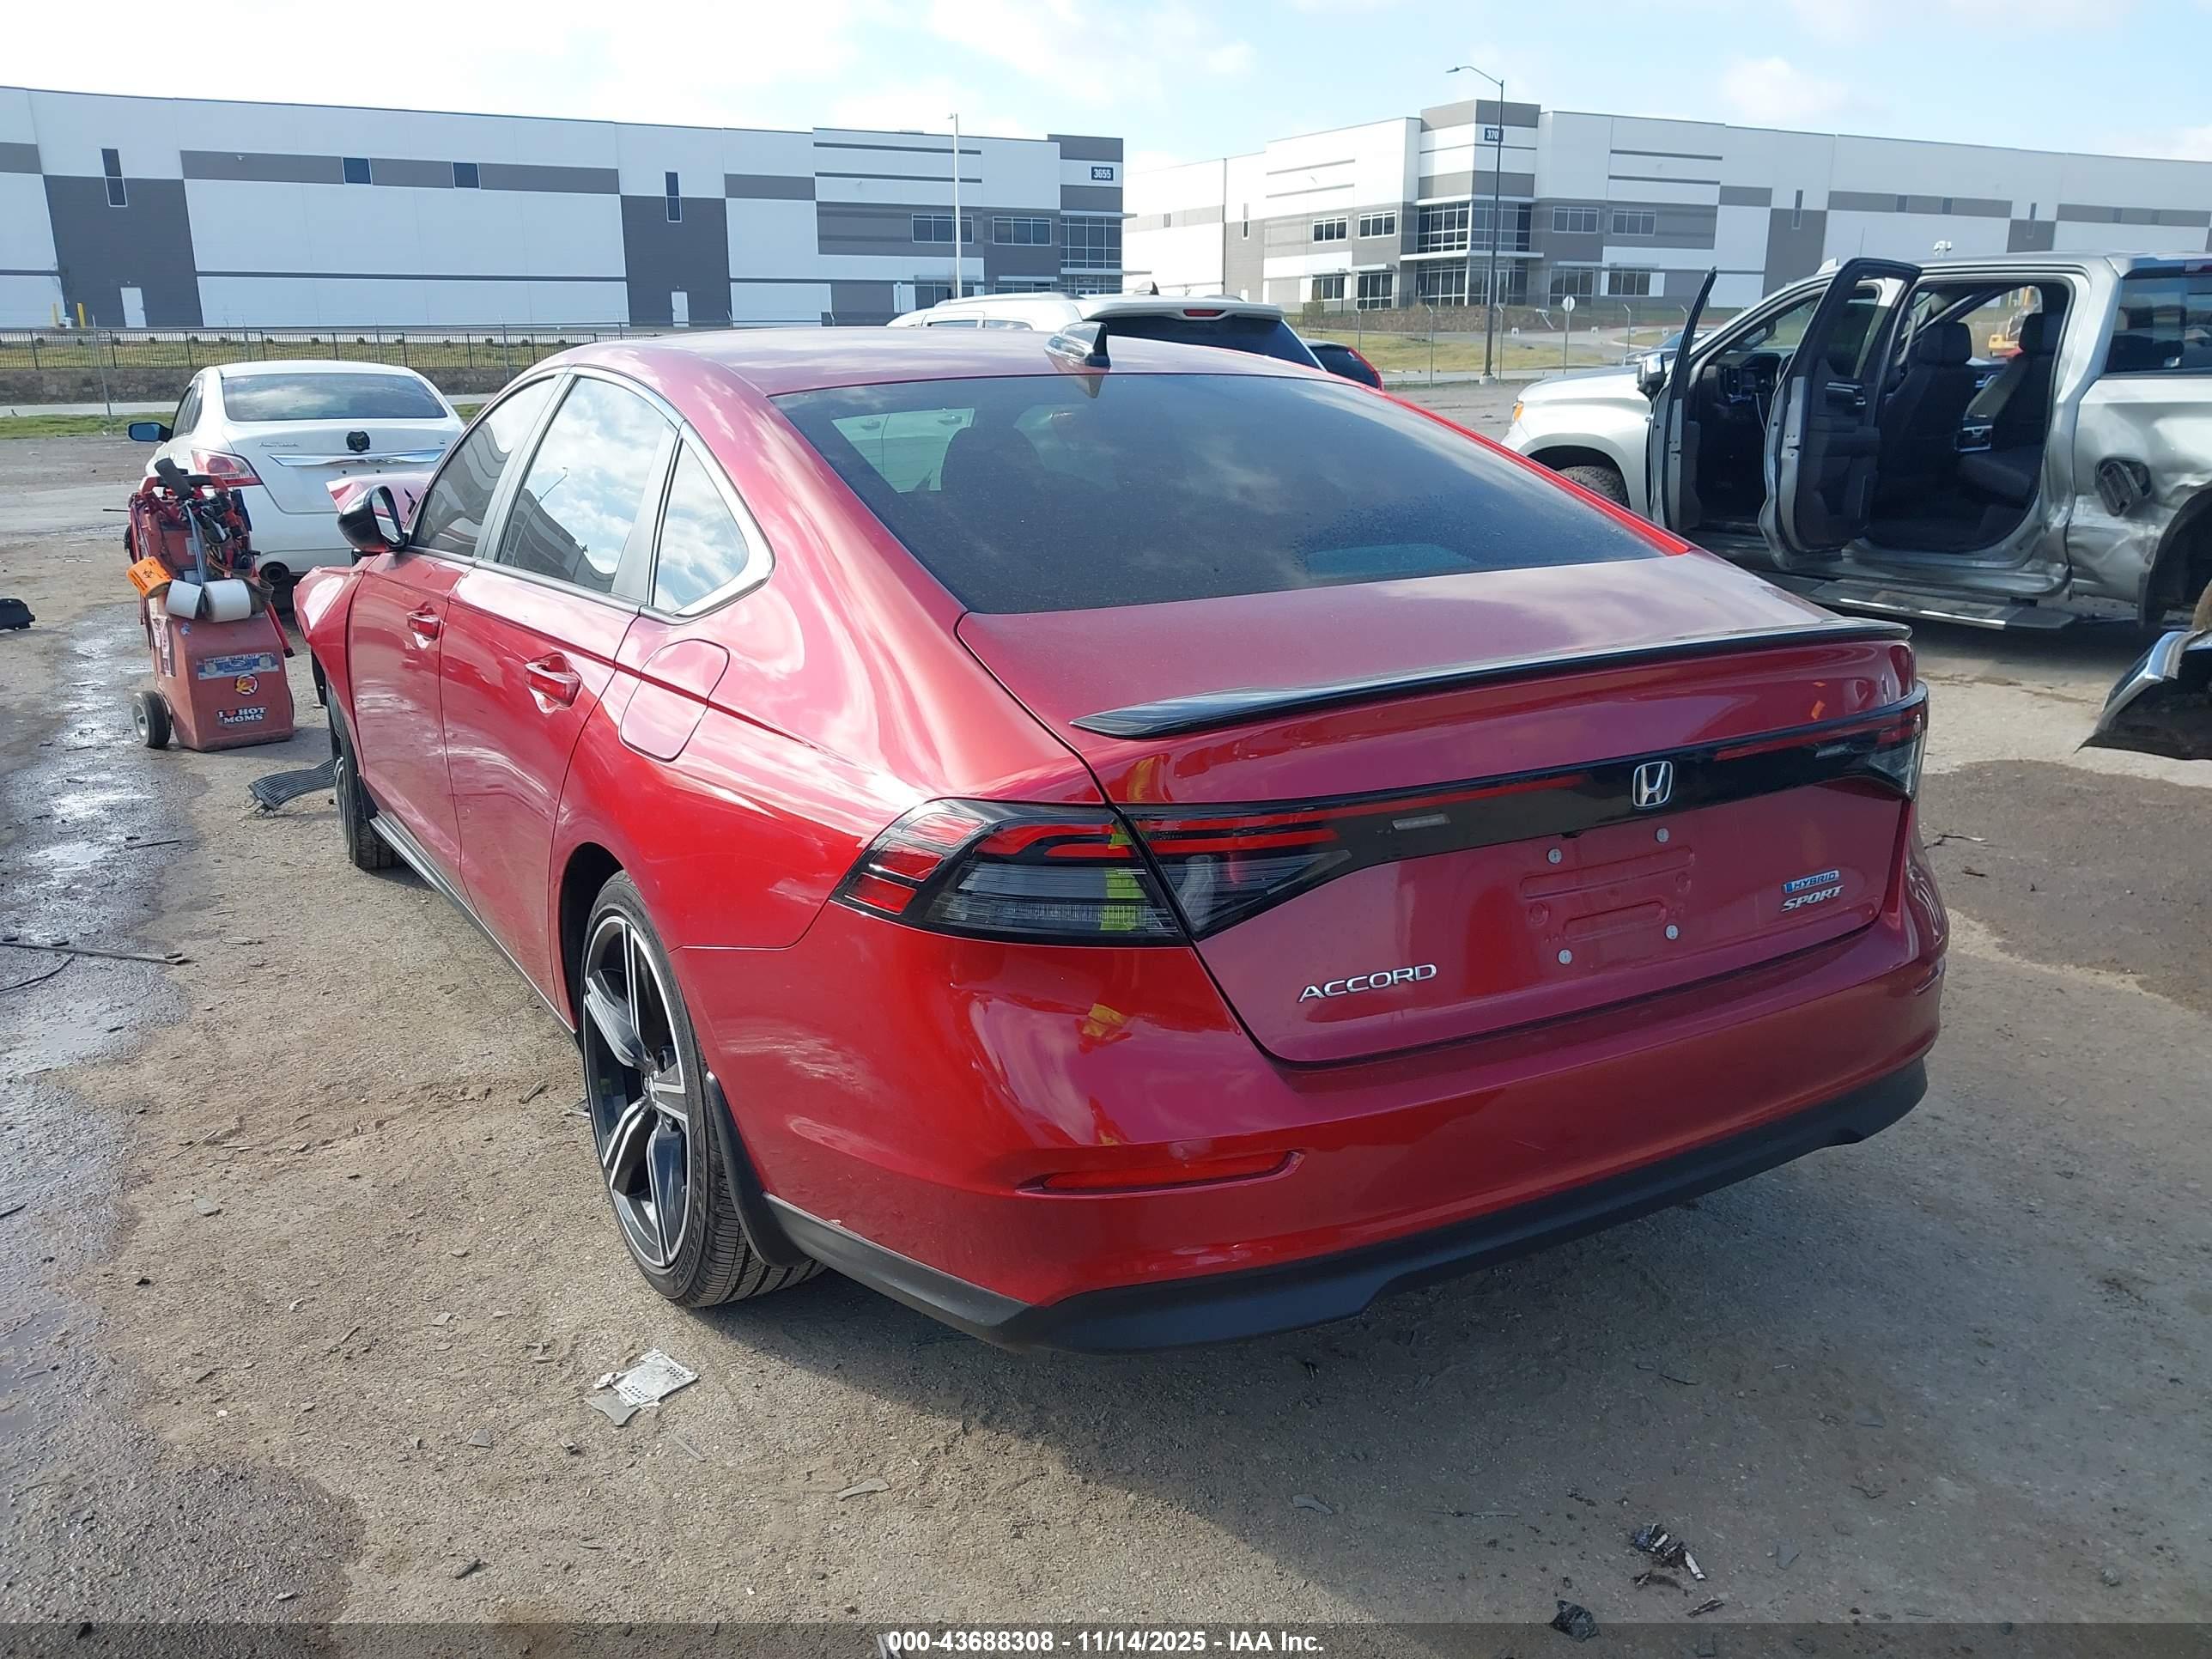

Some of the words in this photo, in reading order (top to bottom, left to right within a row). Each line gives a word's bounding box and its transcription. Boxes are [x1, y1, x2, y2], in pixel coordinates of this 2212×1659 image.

[1486, 129, 1501, 140] 370
[1093, 168, 1111, 179] 3655
[238, 707, 267, 715] HOT
[223, 714, 264, 724] MOMS
[1793, 872, 1836, 890] HYBRID
[1780, 884, 1844, 912] SPORT
[1297, 963, 1437, 1003] ACCORD
